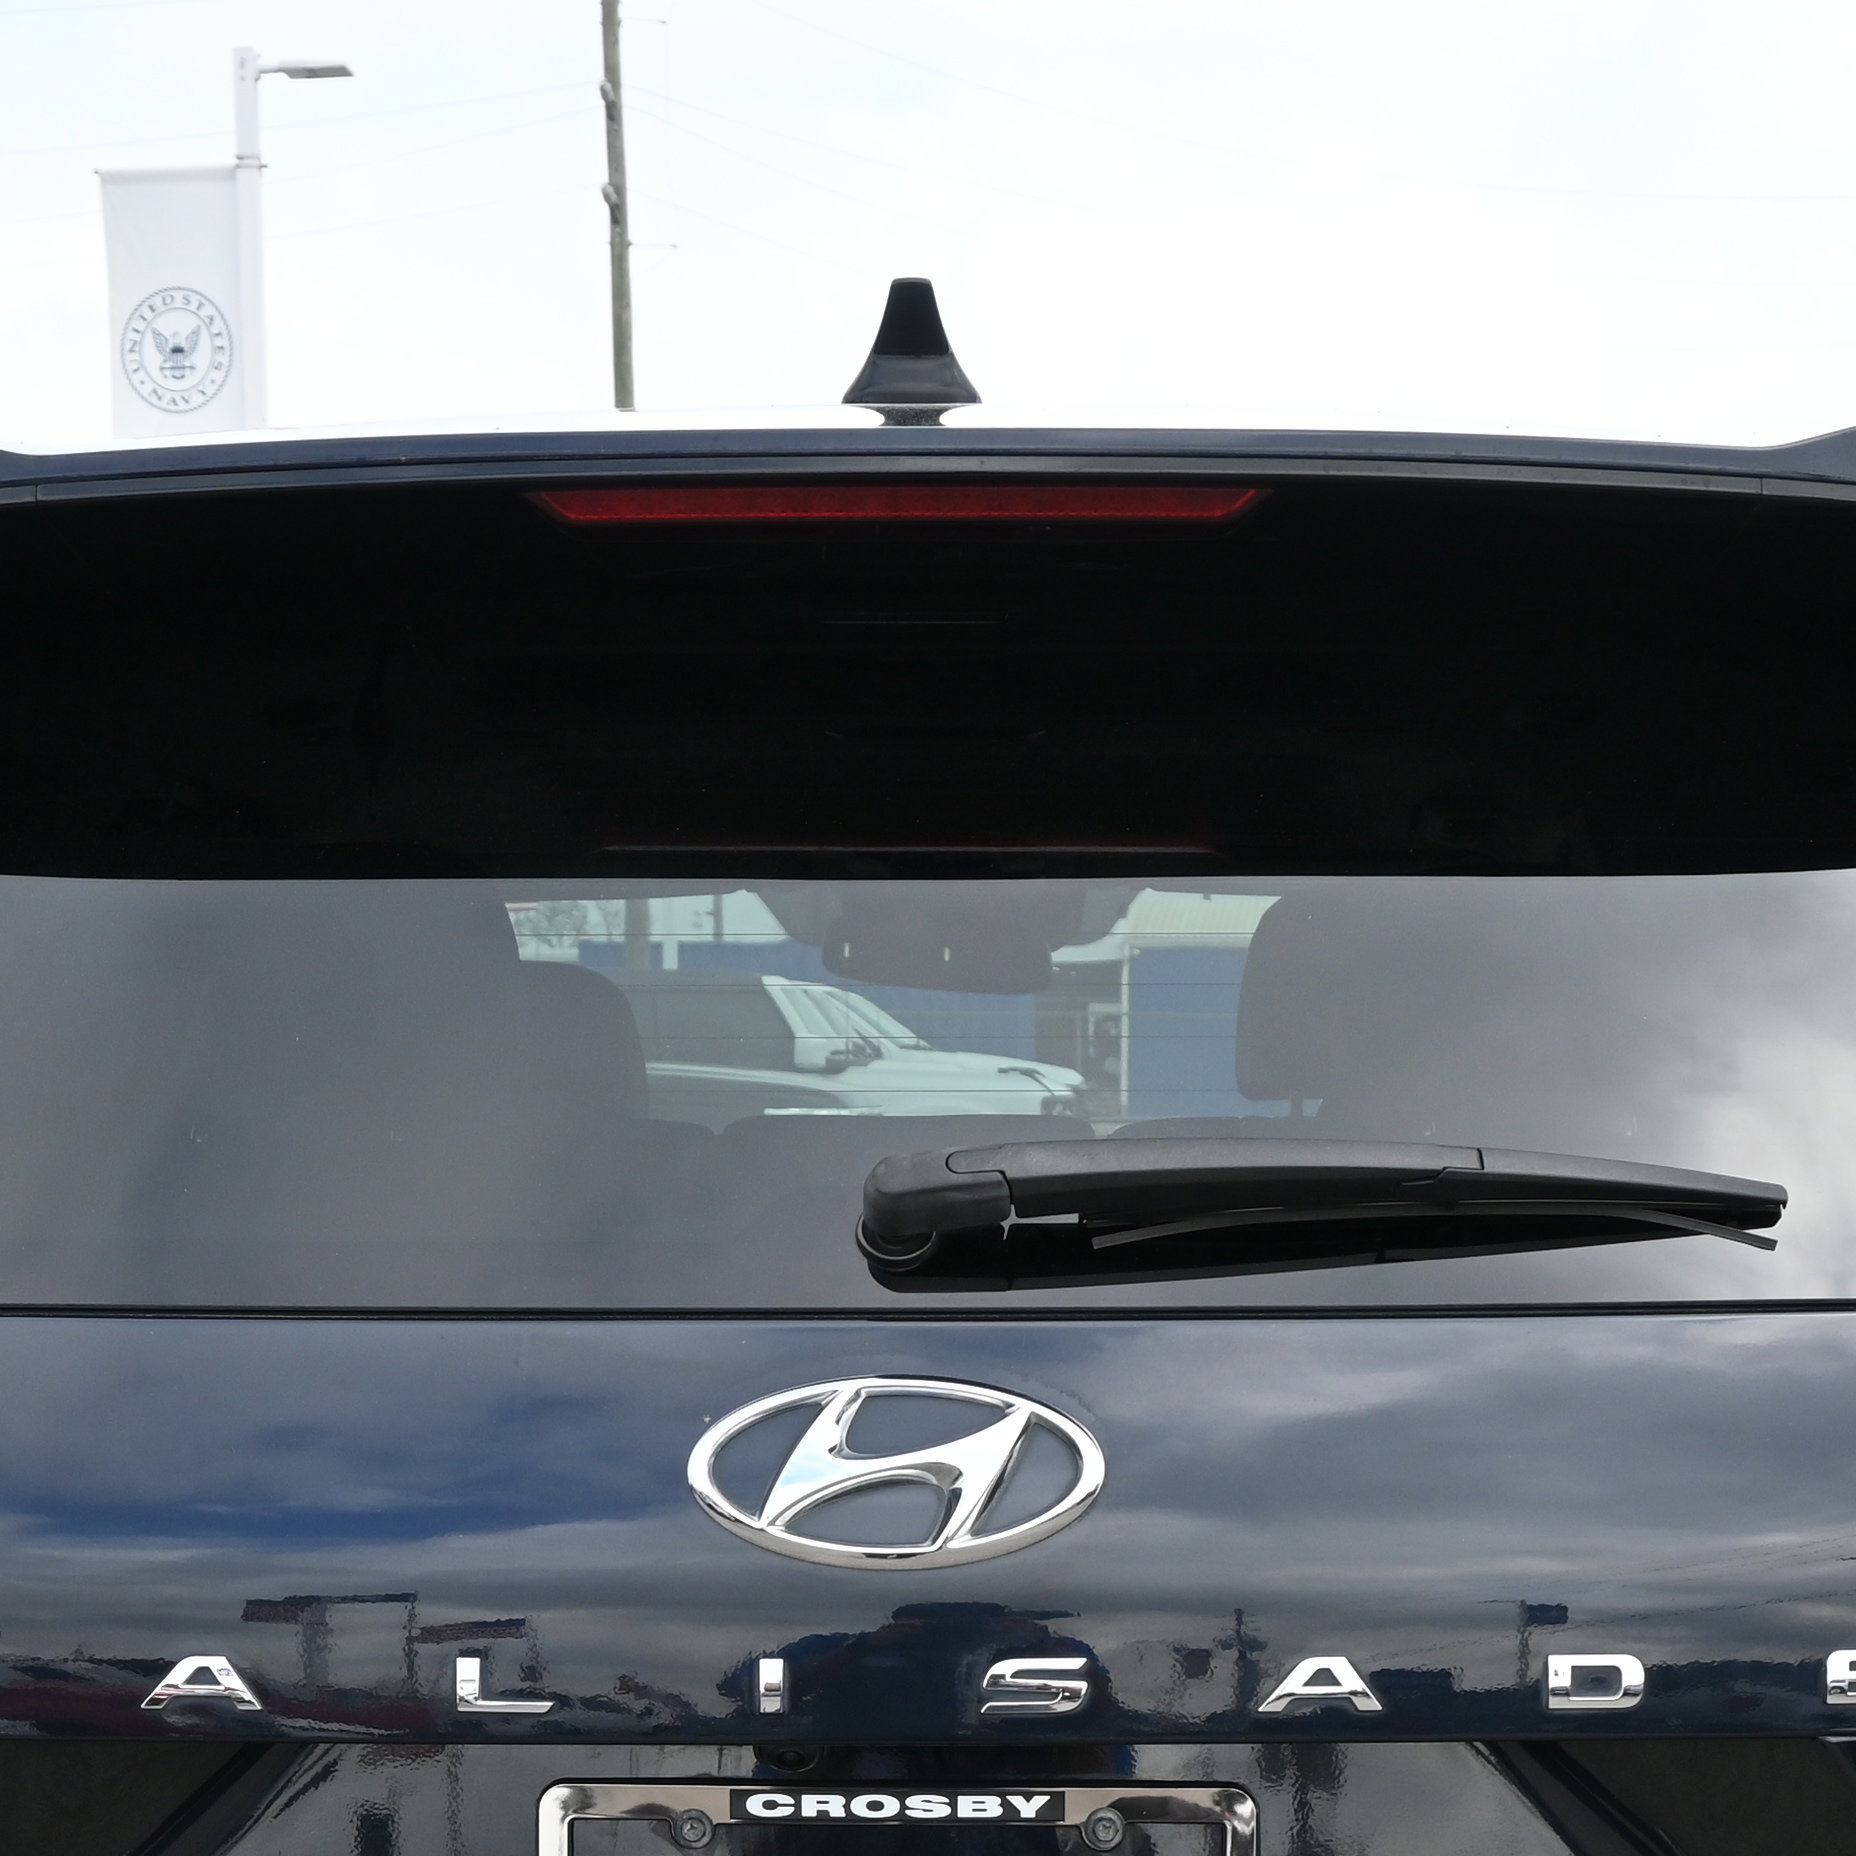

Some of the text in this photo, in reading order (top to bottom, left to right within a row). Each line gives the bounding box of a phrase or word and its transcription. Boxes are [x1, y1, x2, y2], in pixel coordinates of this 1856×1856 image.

[128, 293, 225, 373] UNITED STATES
[150, 384, 207, 407] NAVY
[745, 1792, 1052, 1819] CROSBY
